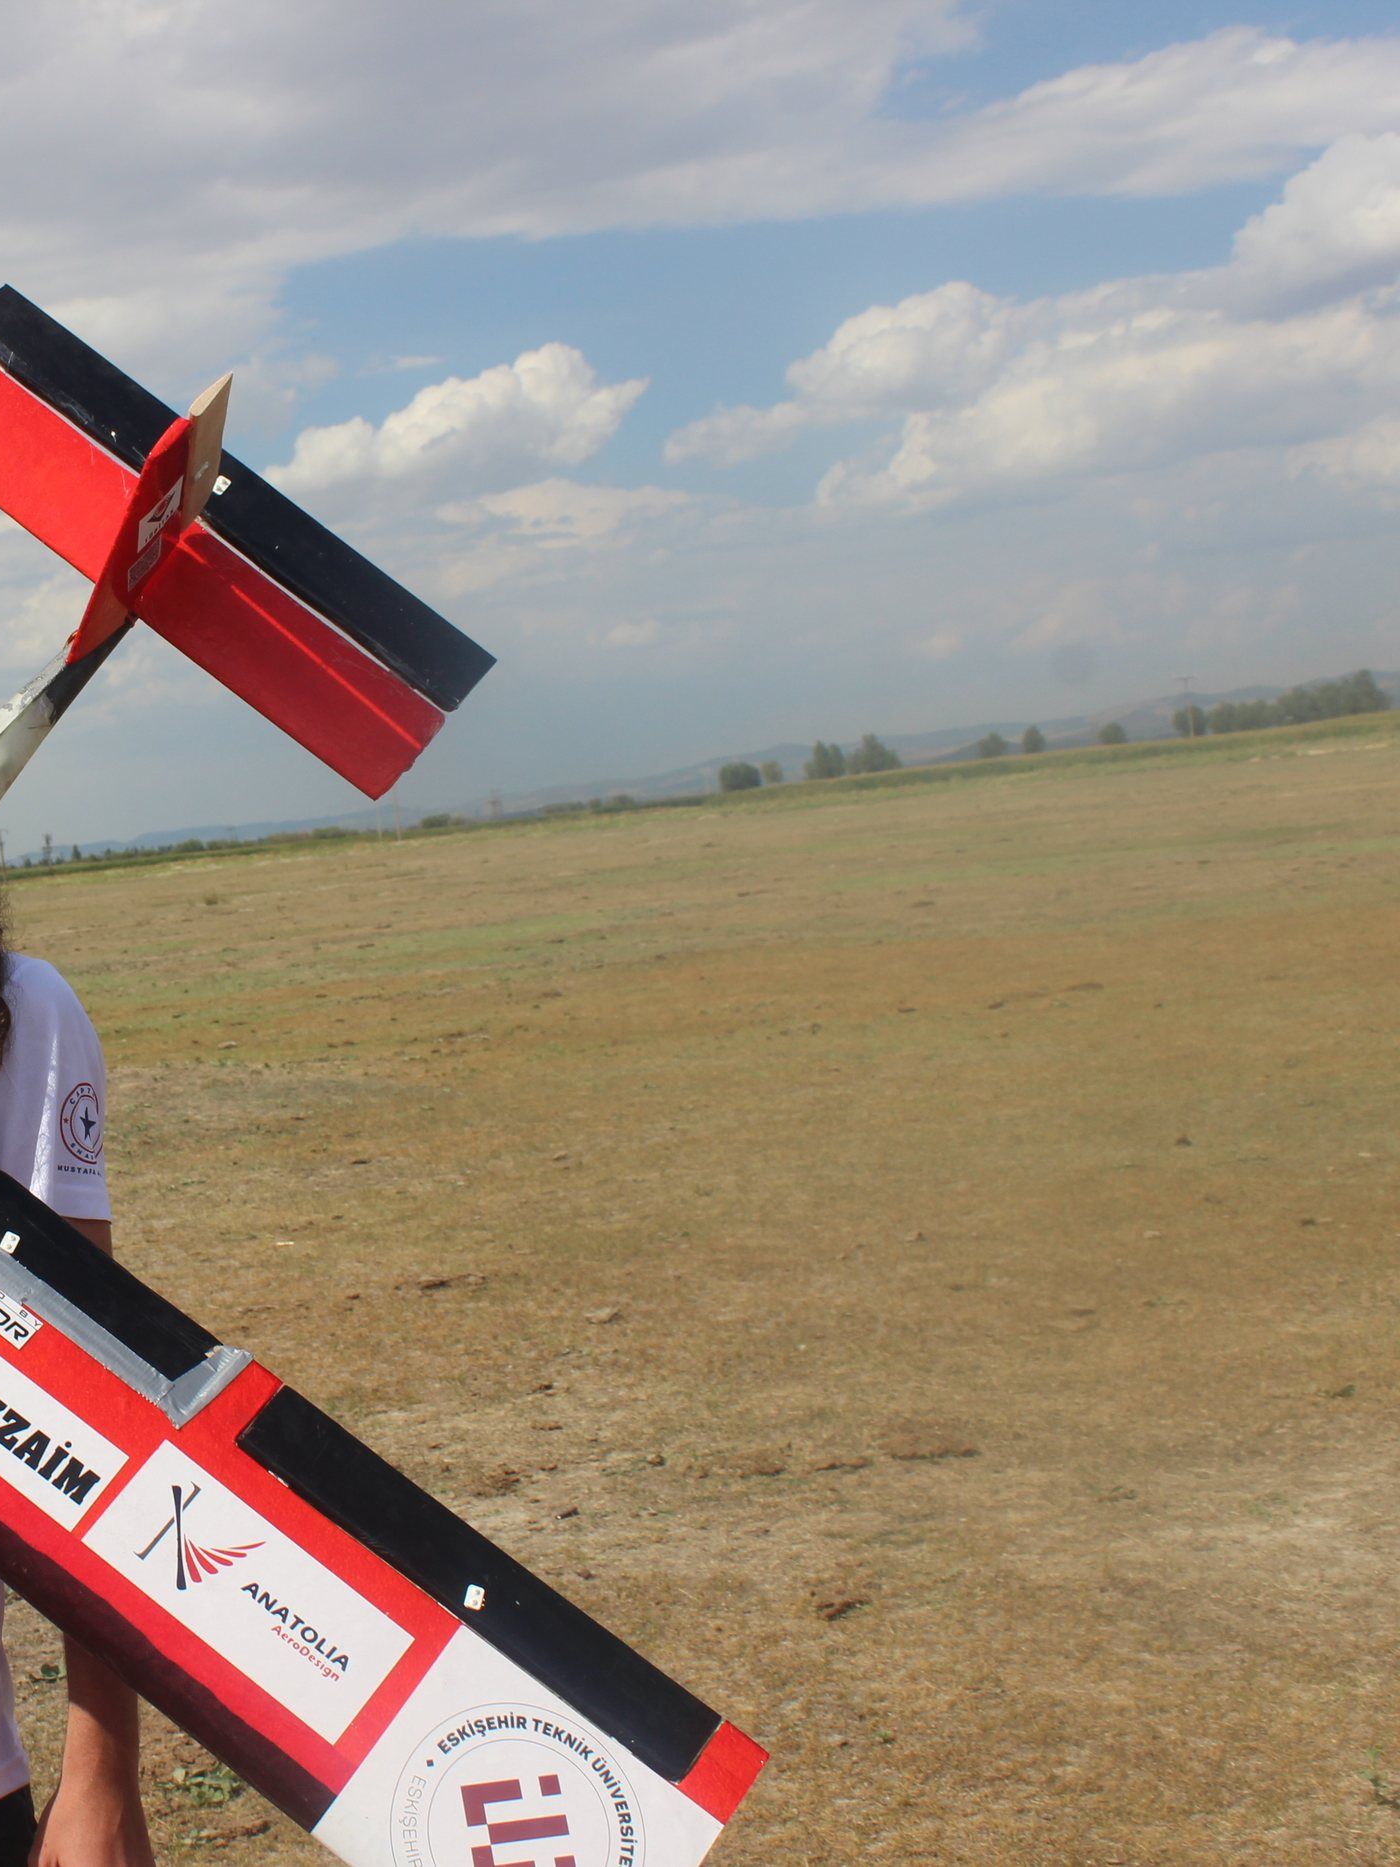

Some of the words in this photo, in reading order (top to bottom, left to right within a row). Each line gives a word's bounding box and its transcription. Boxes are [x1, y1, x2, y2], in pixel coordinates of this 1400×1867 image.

[19, 1309, 42, 1327] BY
[240, 1583, 349, 1672] ANATOLIA
[270, 1625, 340, 1682] AeroDesign
[436, 1712, 527, 1754] ESKİŞEHİR
[532, 1718, 594, 1761] TEKNİK
